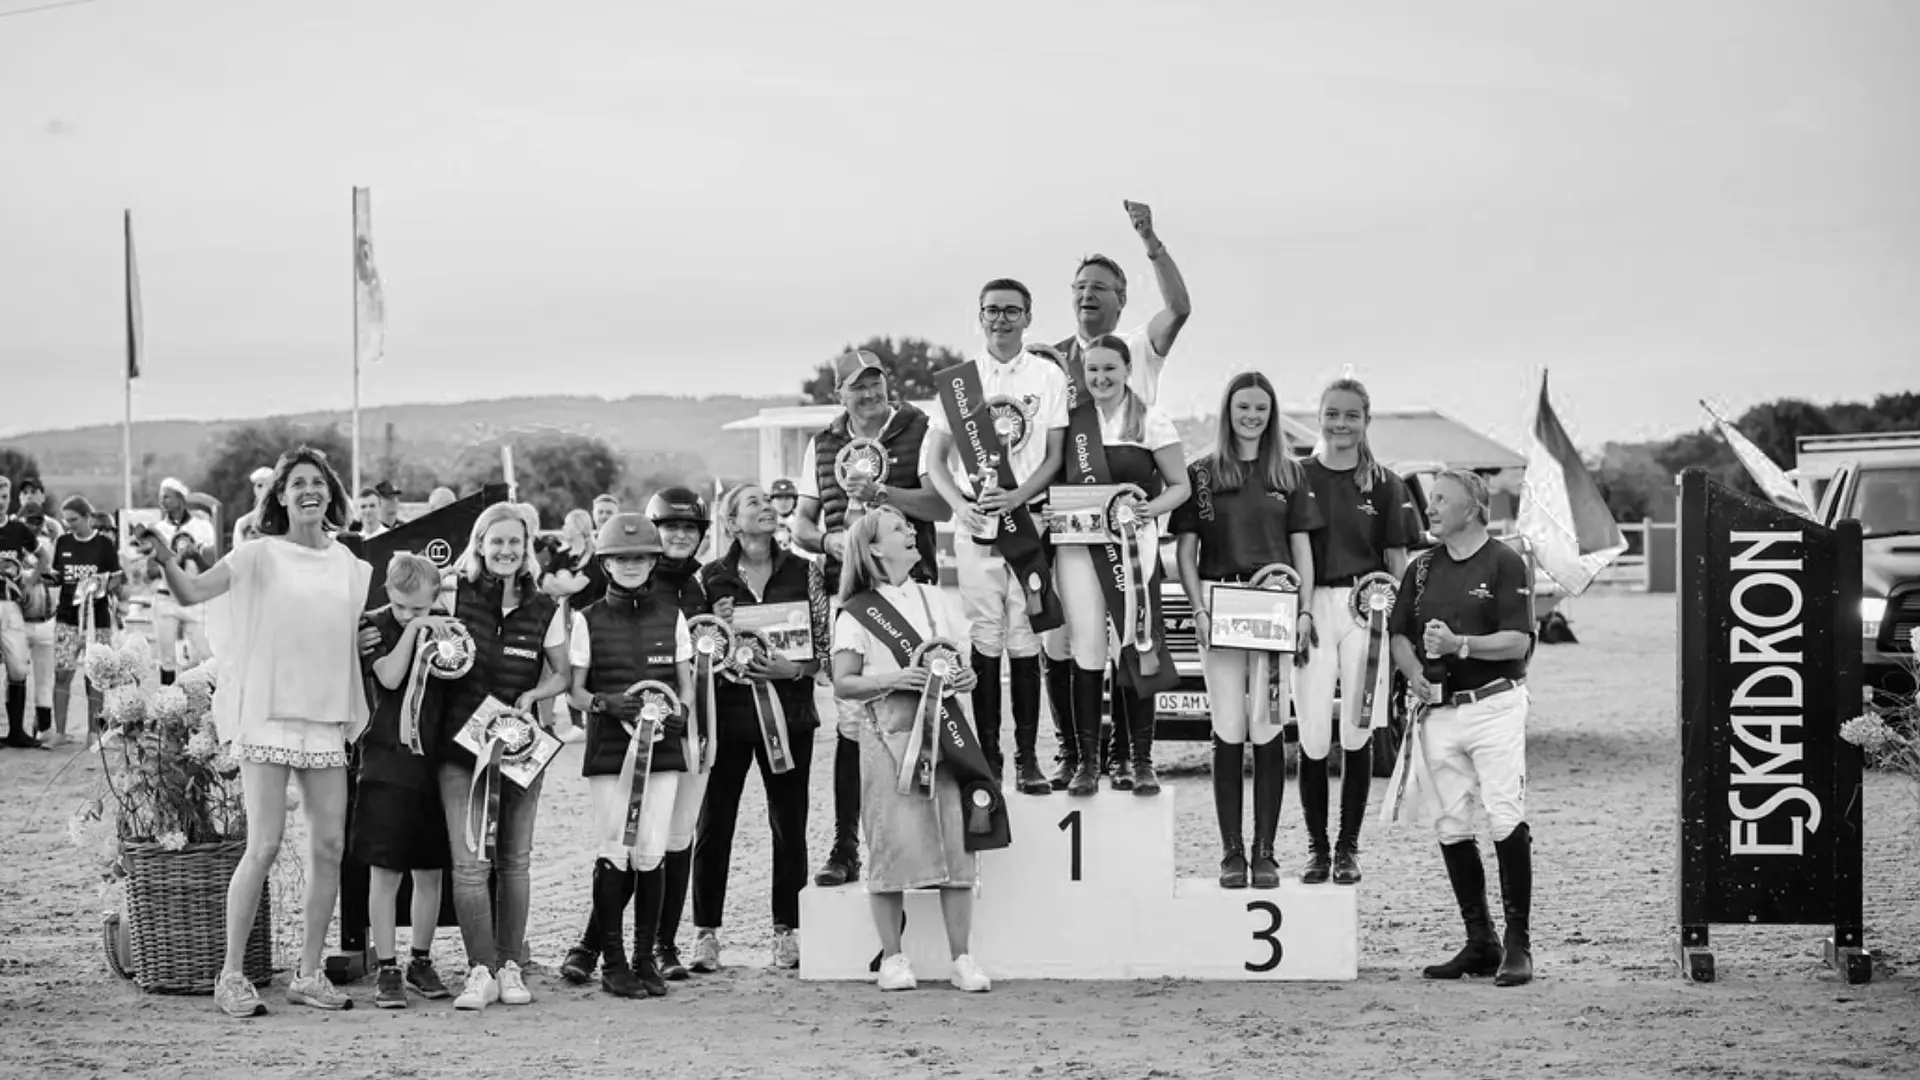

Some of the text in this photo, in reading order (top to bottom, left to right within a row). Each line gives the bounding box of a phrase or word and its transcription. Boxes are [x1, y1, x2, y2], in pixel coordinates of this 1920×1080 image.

[952, 378, 988, 469] Global Charity
[1075, 433, 1093, 473] Global
[1113, 564, 1125, 592] Cup
[866, 607, 903, 639] Global
[1163, 619, 1196, 629] RA
[1159, 695, 1178, 709] OS
[1182, 696, 1200, 709] AM
[1728, 530, 1823, 856] ESKADRON
[947, 721, 965, 748] Cup
[1058, 811, 1082, 881] 1
[1244, 901, 1283, 972] 3
